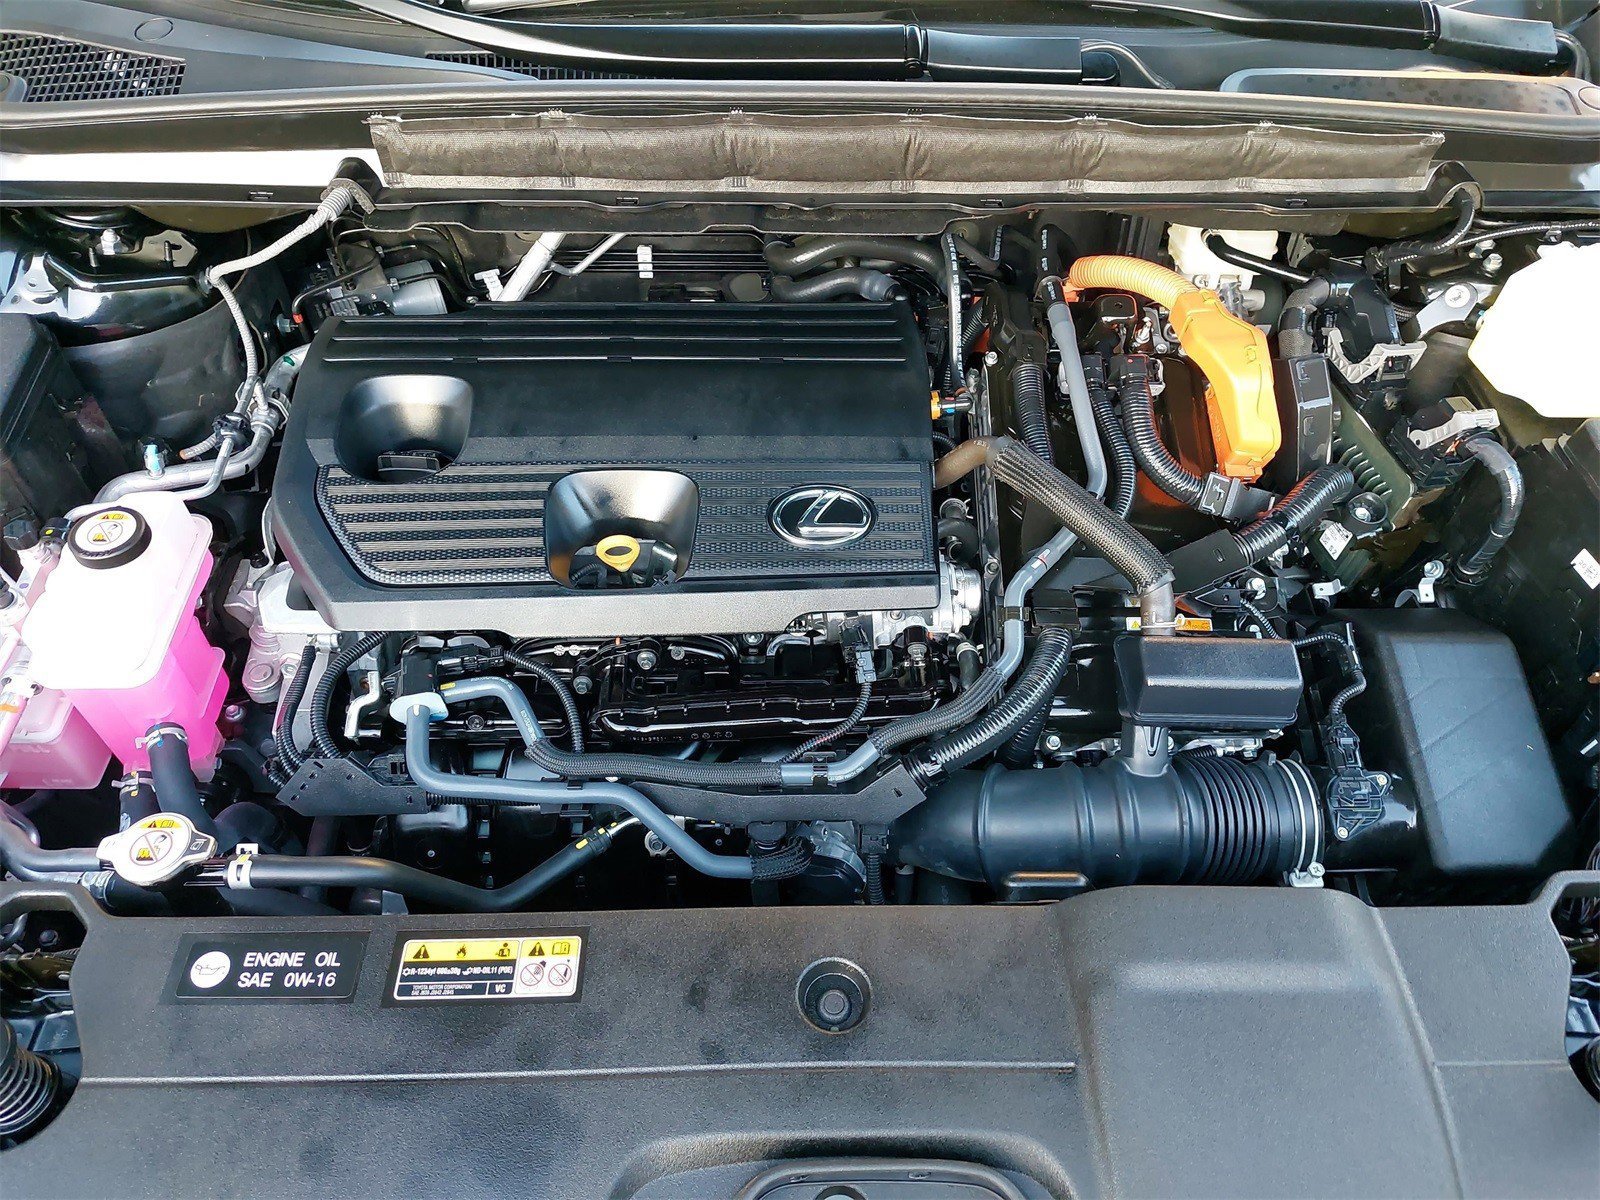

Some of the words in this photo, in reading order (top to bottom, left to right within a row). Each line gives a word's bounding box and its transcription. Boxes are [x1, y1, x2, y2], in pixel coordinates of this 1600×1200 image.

[242, 951, 306, 968] ENGINE
[314, 951, 341, 968] OIL
[237, 971, 274, 988] SAE
[283, 971, 337, 988] 0W-16
[495, 984, 506, 994] VC
